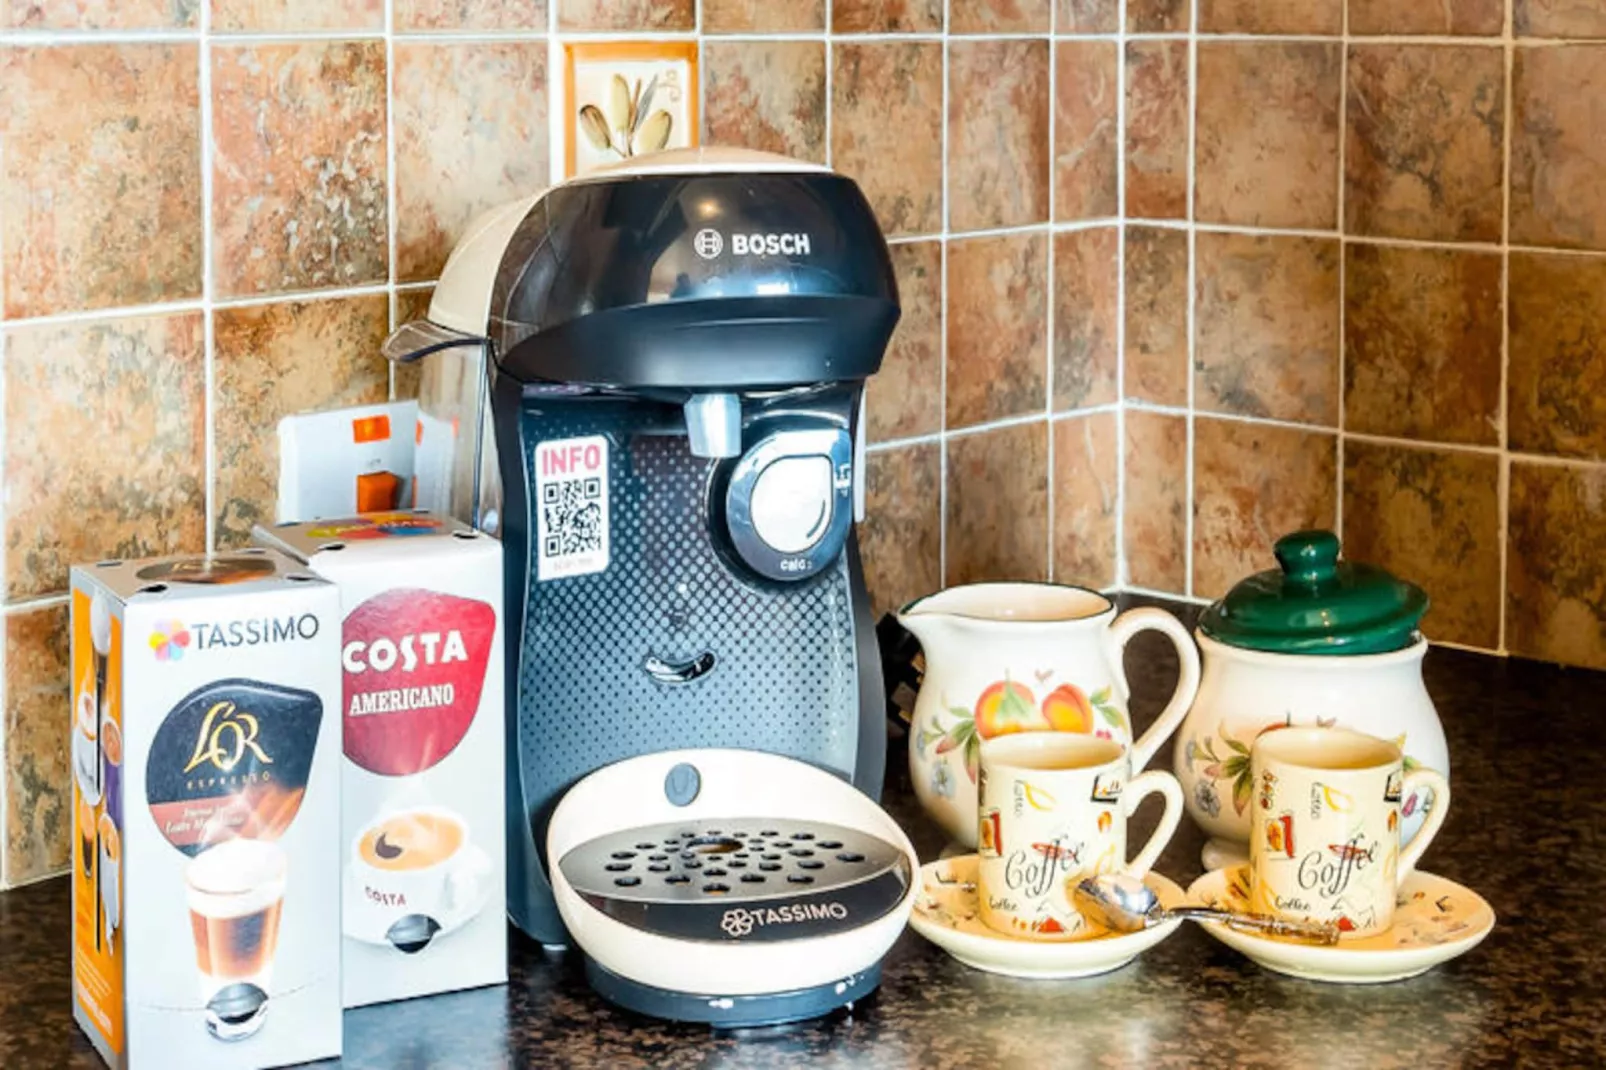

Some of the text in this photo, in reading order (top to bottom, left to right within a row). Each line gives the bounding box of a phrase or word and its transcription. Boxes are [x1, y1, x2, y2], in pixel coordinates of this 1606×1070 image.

[731, 233, 811, 255] BOSCH
[542, 444, 601, 476] INFO
[191, 613, 319, 650] TASSIMO
[342, 630, 469, 673] COSTA
[349, 682, 455, 717] AMERICANO
[365, 886, 406, 906] COSTA
[751, 902, 848, 926] TASSIMO
